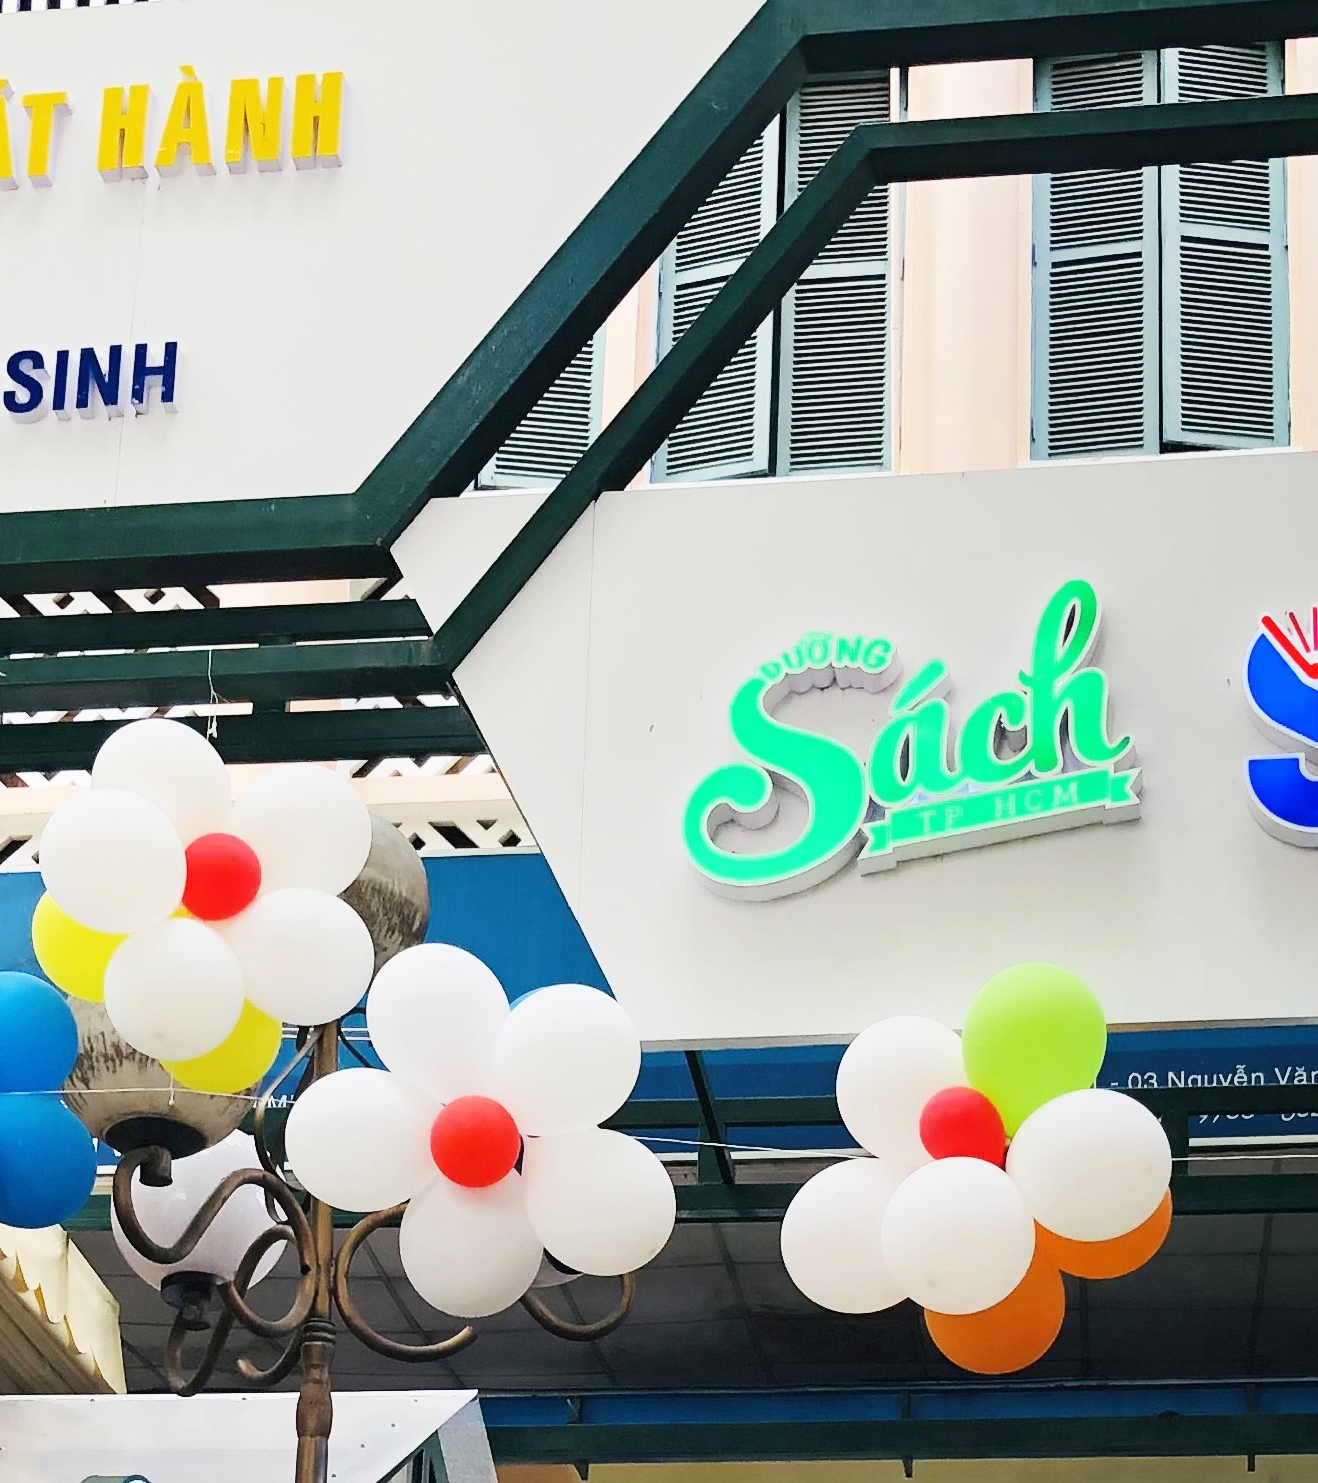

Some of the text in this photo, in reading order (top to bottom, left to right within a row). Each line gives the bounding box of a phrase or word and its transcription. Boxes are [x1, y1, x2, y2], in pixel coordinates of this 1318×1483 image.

[98, 64, 344, 170] HÀNH
[2, 341, 178, 413] SINH
[682, 579, 1131, 885] Sách
[917, 781, 1079, 834] TP HCM
